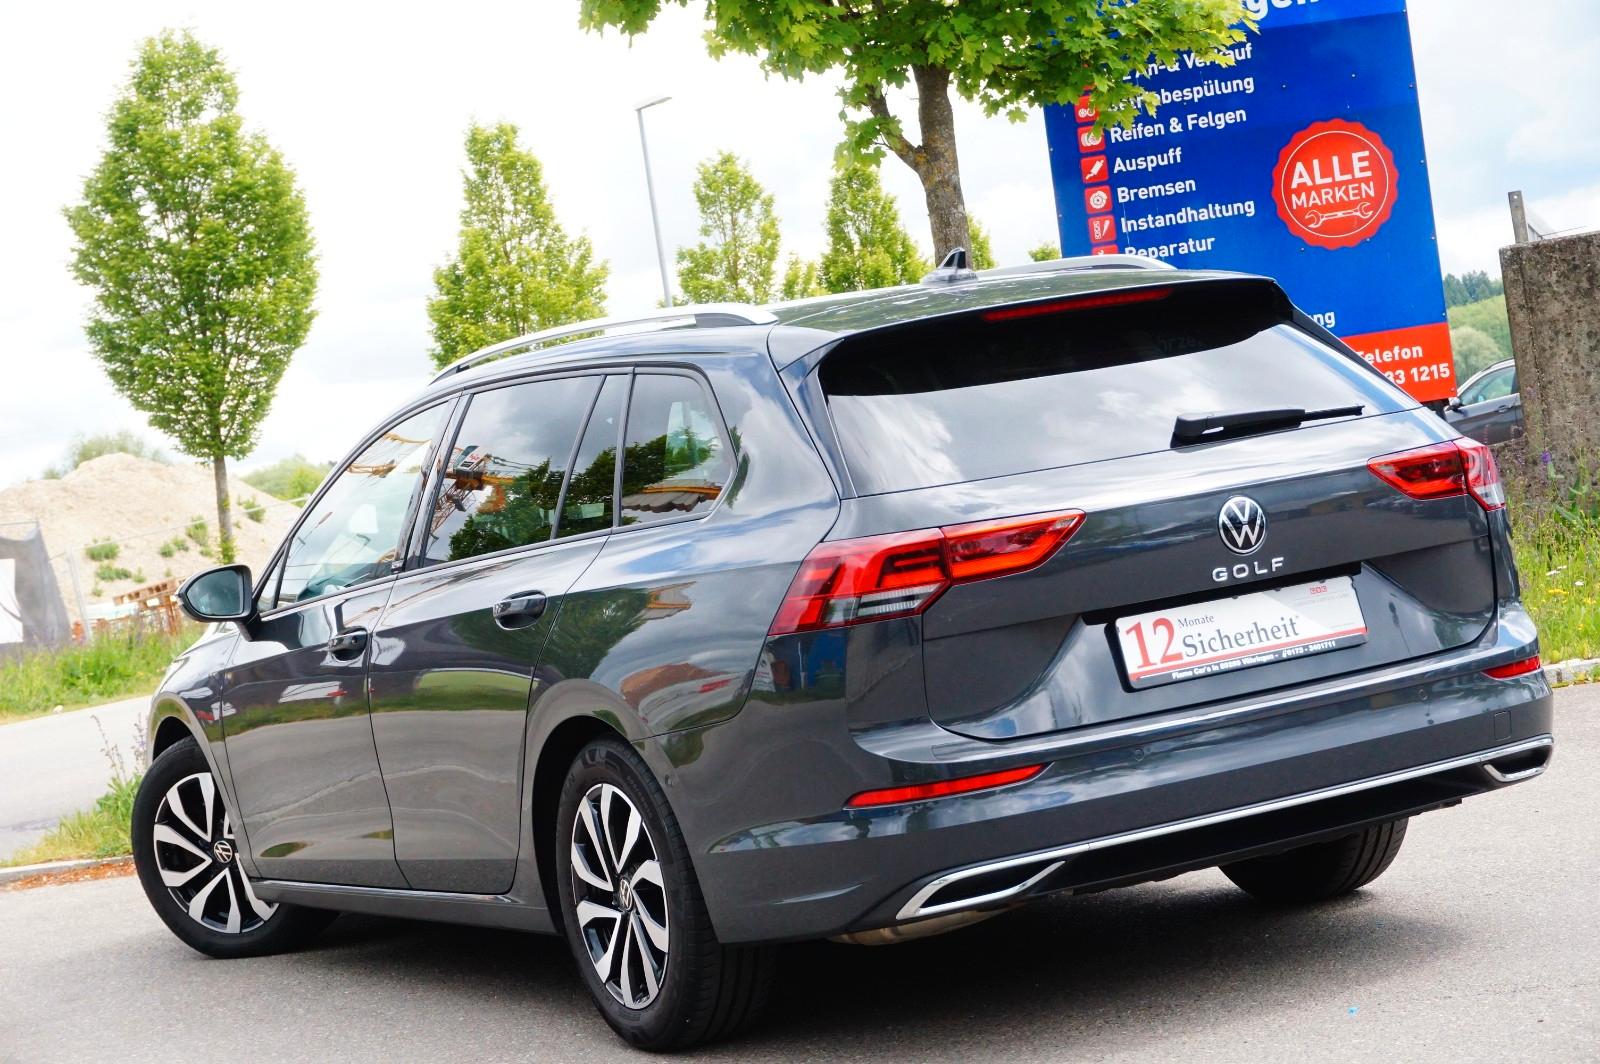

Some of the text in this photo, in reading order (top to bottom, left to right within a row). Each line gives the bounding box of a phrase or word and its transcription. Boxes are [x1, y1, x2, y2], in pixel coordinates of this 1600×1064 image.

[1182, 42, 1252, 69] Veauf
[1110, 109, 1247, 143] Reifen & Felgen
[1113, 147, 1182, 173] Auspuff
[1291, 150, 1372, 189] ALLE
[1116, 179, 1196, 204] Bremsen
[1291, 181, 1375, 210] MARKEN
[1120, 200, 1255, 233] Instandhaltung
[1124, 238, 1215, 259] Reparatur
[1411, 363, 1450, 382] 1215
[1219, 495, 1266, 554] VW
[1212, 557, 1284, 582] GOLF
[1178, 614, 1215, 629] Monate
[1125, 617, 1184, 669] 12
[1182, 616, 1299, 658] Sicherheit
